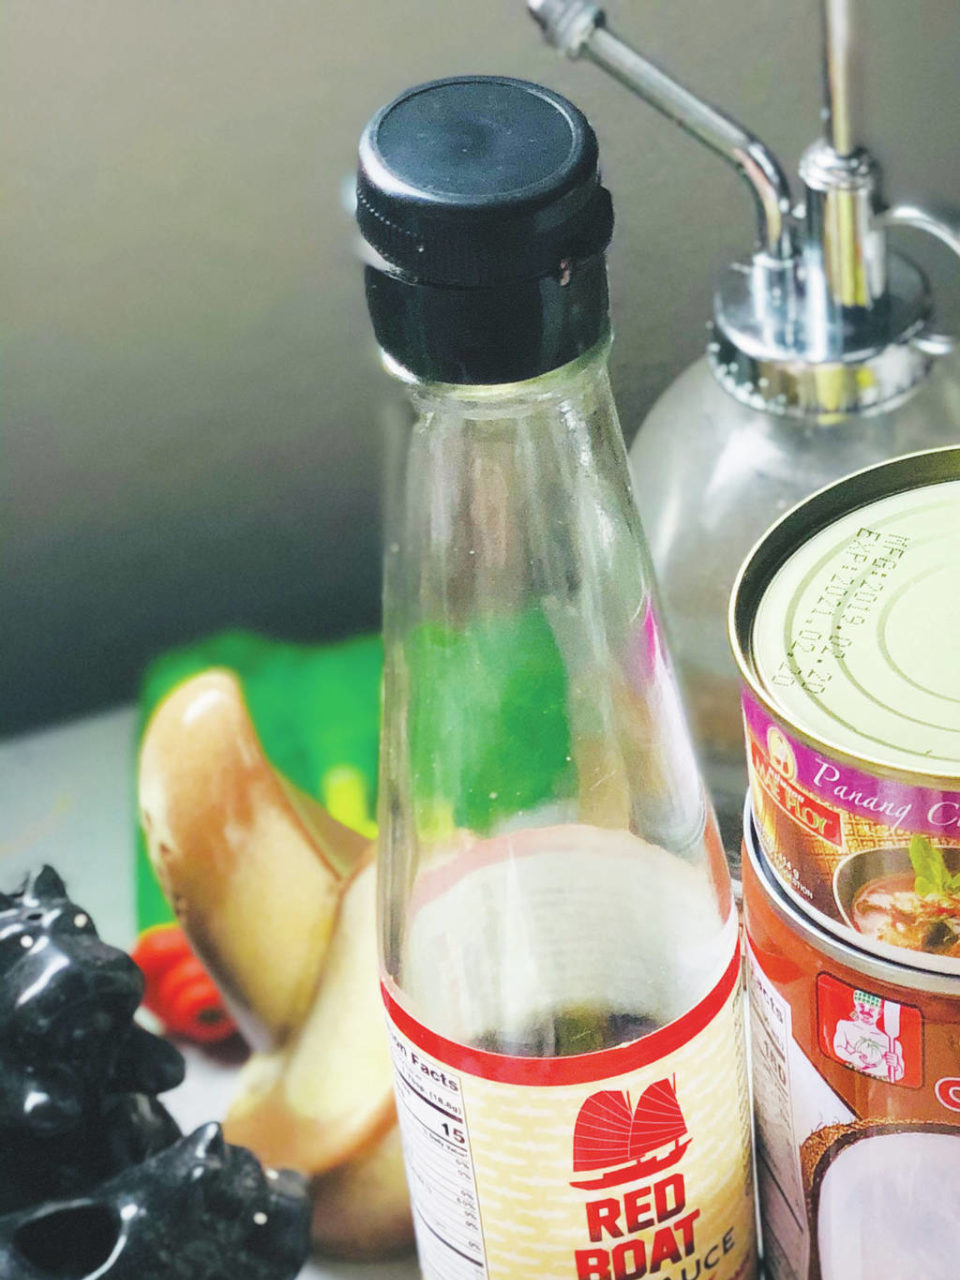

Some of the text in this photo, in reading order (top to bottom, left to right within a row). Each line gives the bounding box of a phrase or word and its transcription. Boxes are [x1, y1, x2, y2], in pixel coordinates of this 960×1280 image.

[813, 758, 912, 834] Panang
[411, 1053, 459, 1092] Facts
[441, 1122, 466, 1145] 15
[585, 1173, 686, 1242] RED
